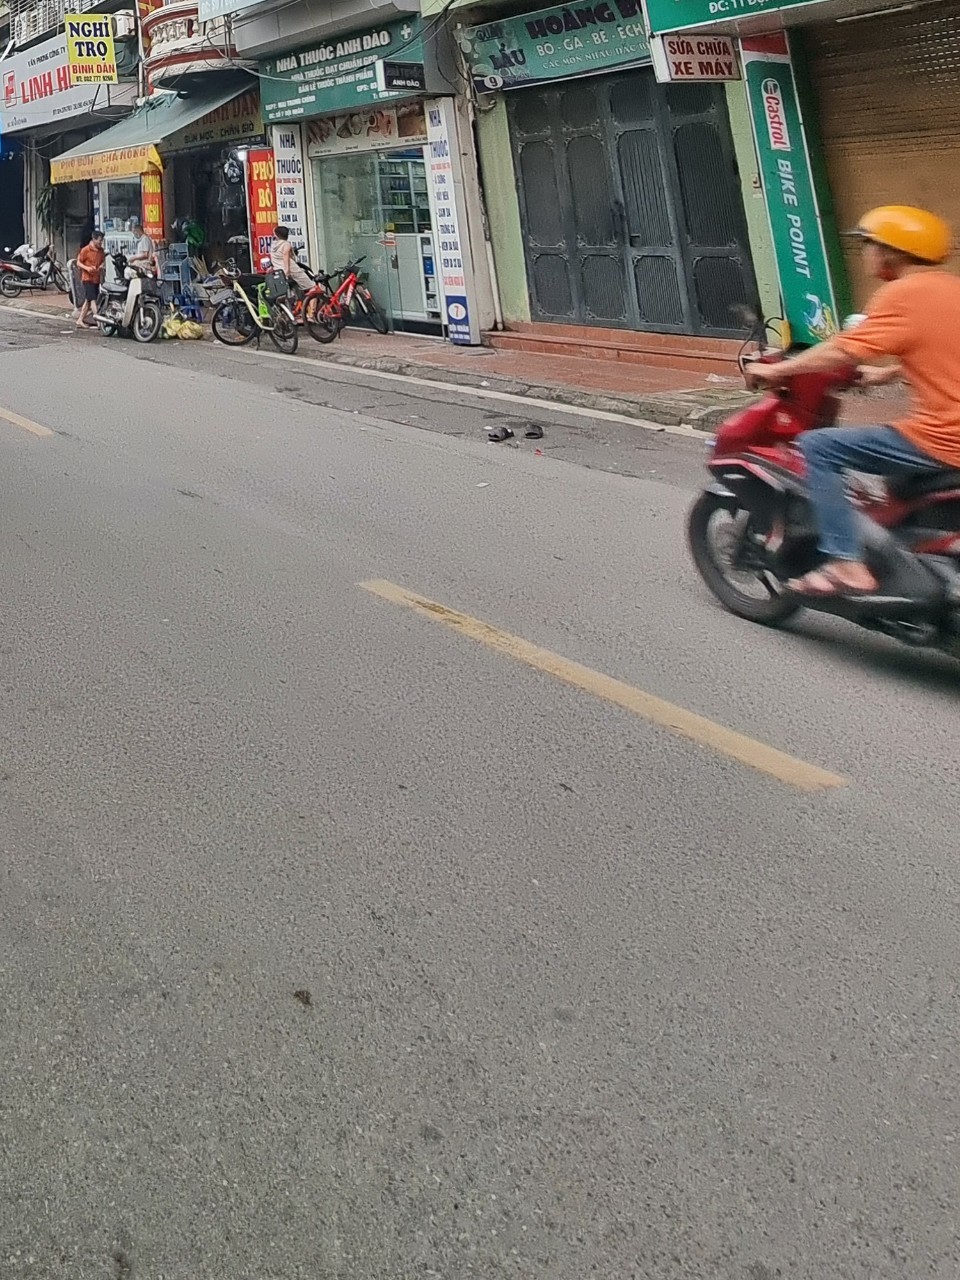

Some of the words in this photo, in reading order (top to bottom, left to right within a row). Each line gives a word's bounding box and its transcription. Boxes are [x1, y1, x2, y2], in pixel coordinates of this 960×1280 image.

[709, 0, 730, 14] ĐC:
[68, 16, 110, 38] NGHỈ
[74, 41, 108, 61] TRỌ
[276, 52, 298, 73] NHÀ
[299, 41, 334, 67] THUỐC
[336, 38, 362, 59] ANH
[362, 29, 390, 50] ĐÀO
[667, 34, 695, 55] SỬA
[696, 37, 731, 56] CHỮA
[72, 63, 94, 74] BÌNH
[96, 62, 115, 74] DÂN
[672, 61, 695, 76] XE
[698, 58, 733, 76] MÁY
[21, 71, 54, 104] LINH
[489, 76, 498, 87] 9
[766, 95, 787, 145] Castrol
[279, 131, 296, 149] NHÀ
[252, 153, 274, 181] PHỞ
[276, 154, 302, 175] THUỐC
[777, 158, 798, 207] BIKE
[258, 183, 273, 208] BÒ
[259, 236, 277, 254] PH
[786, 213, 810, 279] POINT
